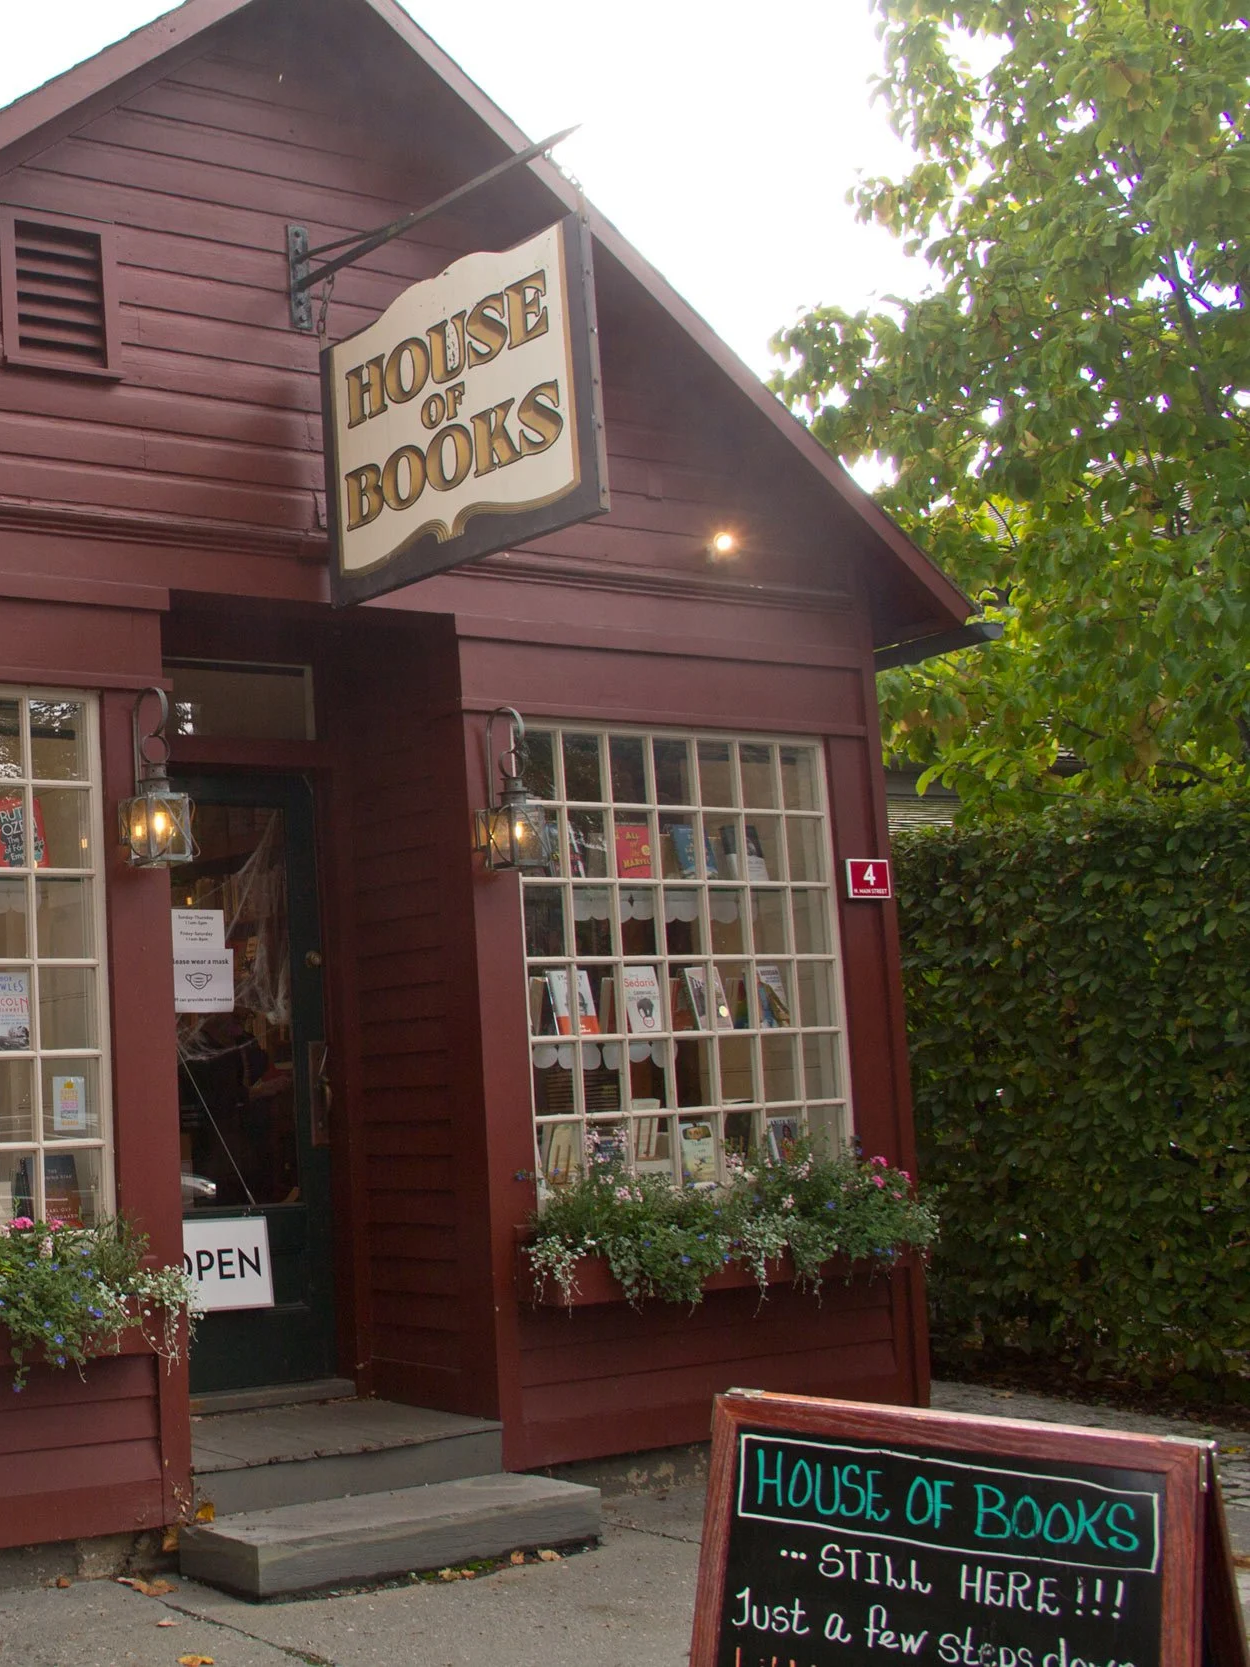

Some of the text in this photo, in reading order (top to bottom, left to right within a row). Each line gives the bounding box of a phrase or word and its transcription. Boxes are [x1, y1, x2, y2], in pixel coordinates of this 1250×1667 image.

[346, 269, 549, 430] HOUSE
[421, 381, 466, 430] OF
[344, 379, 564, 532] BOOKS
[0, 806, 23, 823] RUT
[863, 864, 876, 886] 4
[756, 1448, 1140, 1553] HOUSE OF BOOKS
[731, 1586, 811, 1633] Just
[823, 1612, 852, 1644] a
[863, 1604, 929, 1655] few
